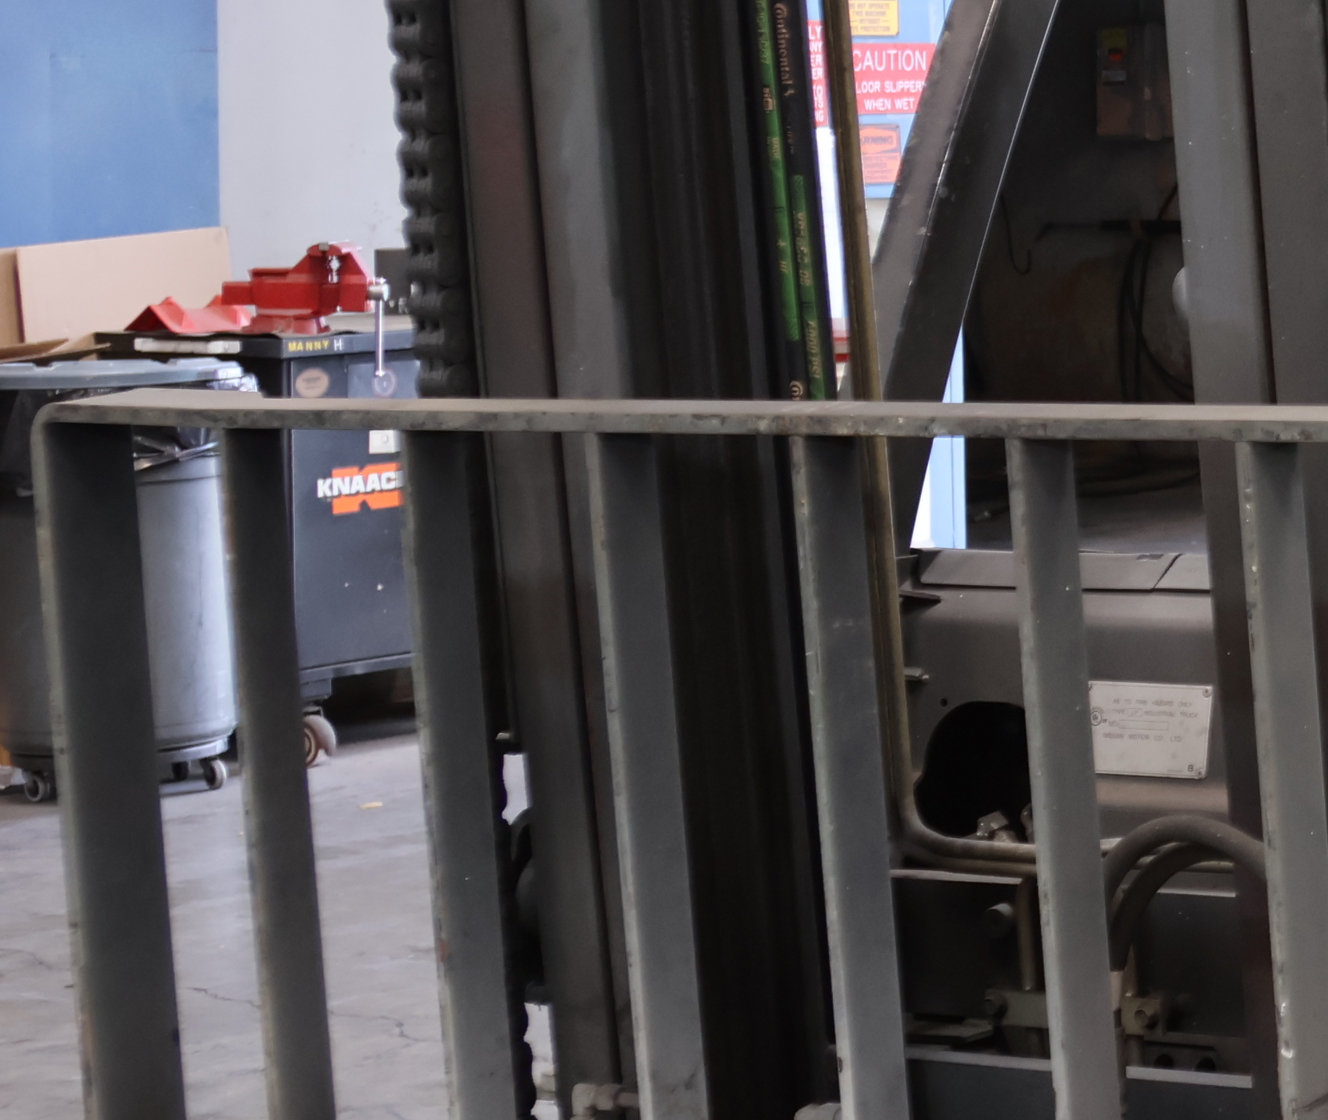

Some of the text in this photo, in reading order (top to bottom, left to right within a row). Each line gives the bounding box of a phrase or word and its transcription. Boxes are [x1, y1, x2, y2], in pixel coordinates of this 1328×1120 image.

[774, 1, 794, 85] Continental
[853, 50, 926, 71] CAUTION
[856, 82, 881, 93] LOOR
[864, 98, 914, 110] WHEN WET
[288, 339, 343, 352] MANNY H
[317, 470, 404, 498] KNAAC
